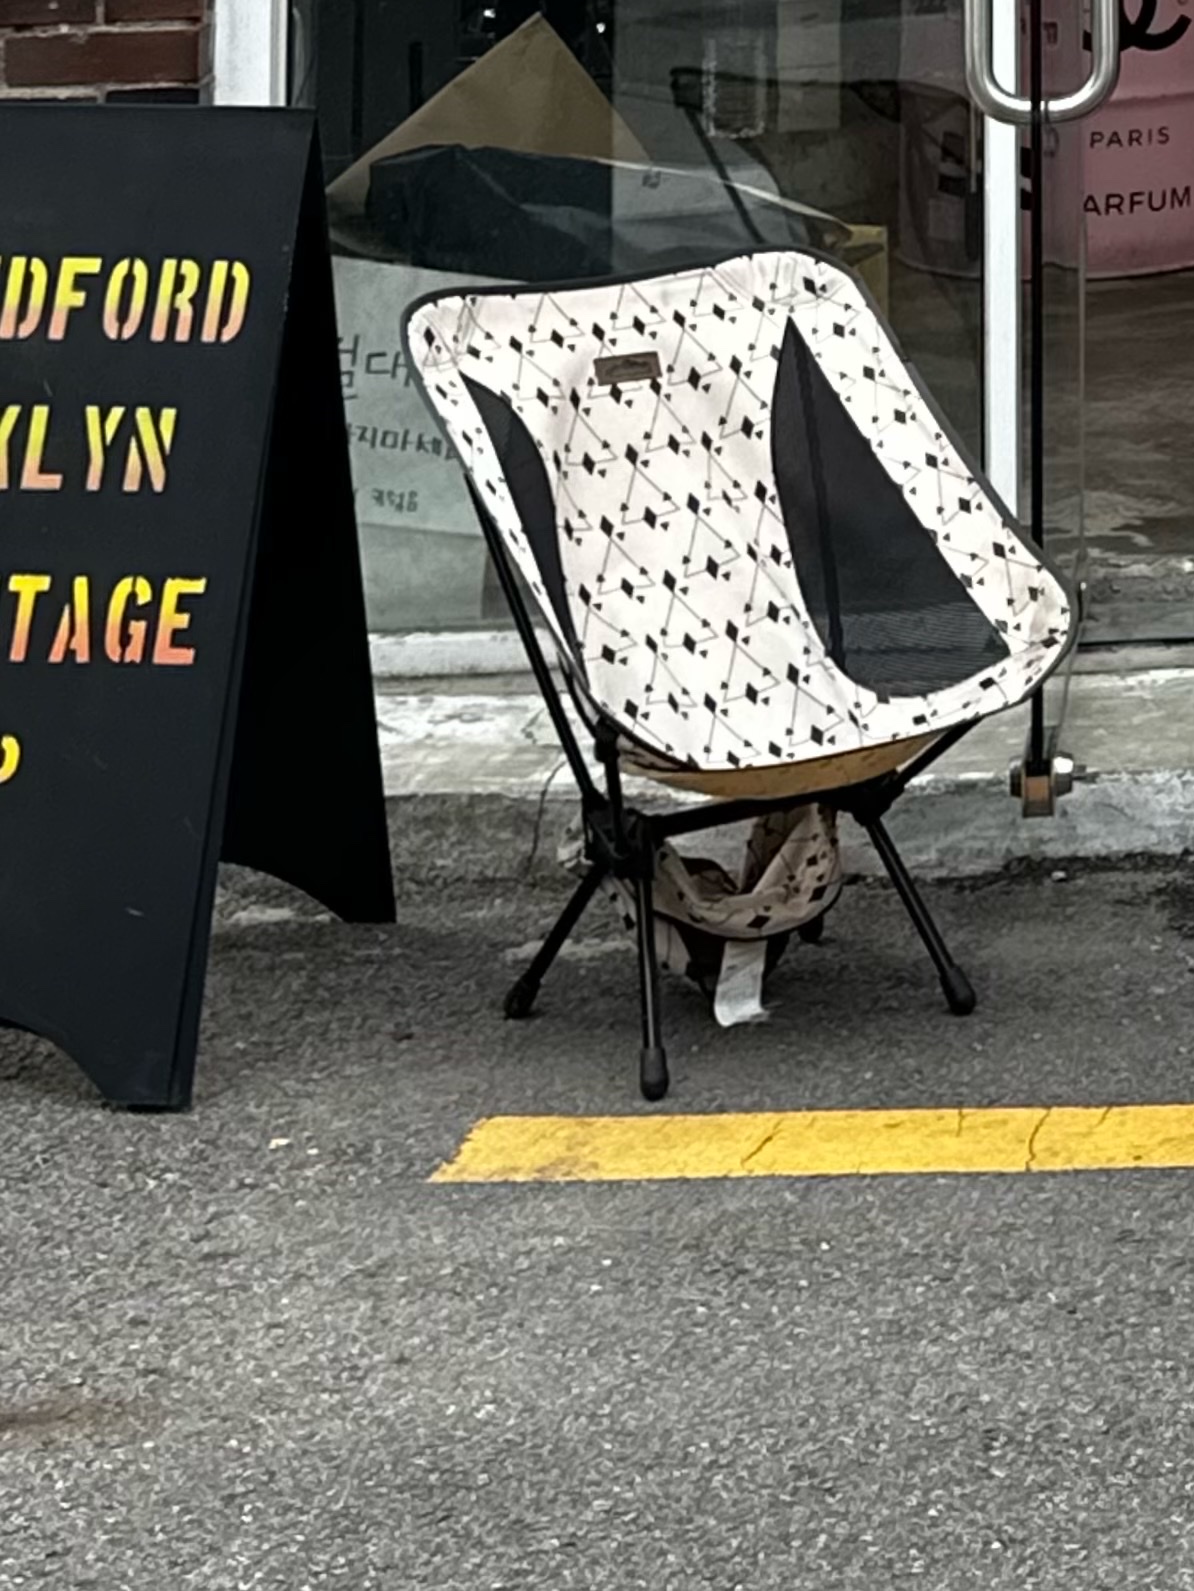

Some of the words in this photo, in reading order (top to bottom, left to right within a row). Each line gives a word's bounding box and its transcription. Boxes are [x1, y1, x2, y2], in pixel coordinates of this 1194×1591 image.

[1089, 125, 1172, 149] PARIS
[0, 255, 251, 344] DFORD
[8, 574, 208, 665] TAGE
